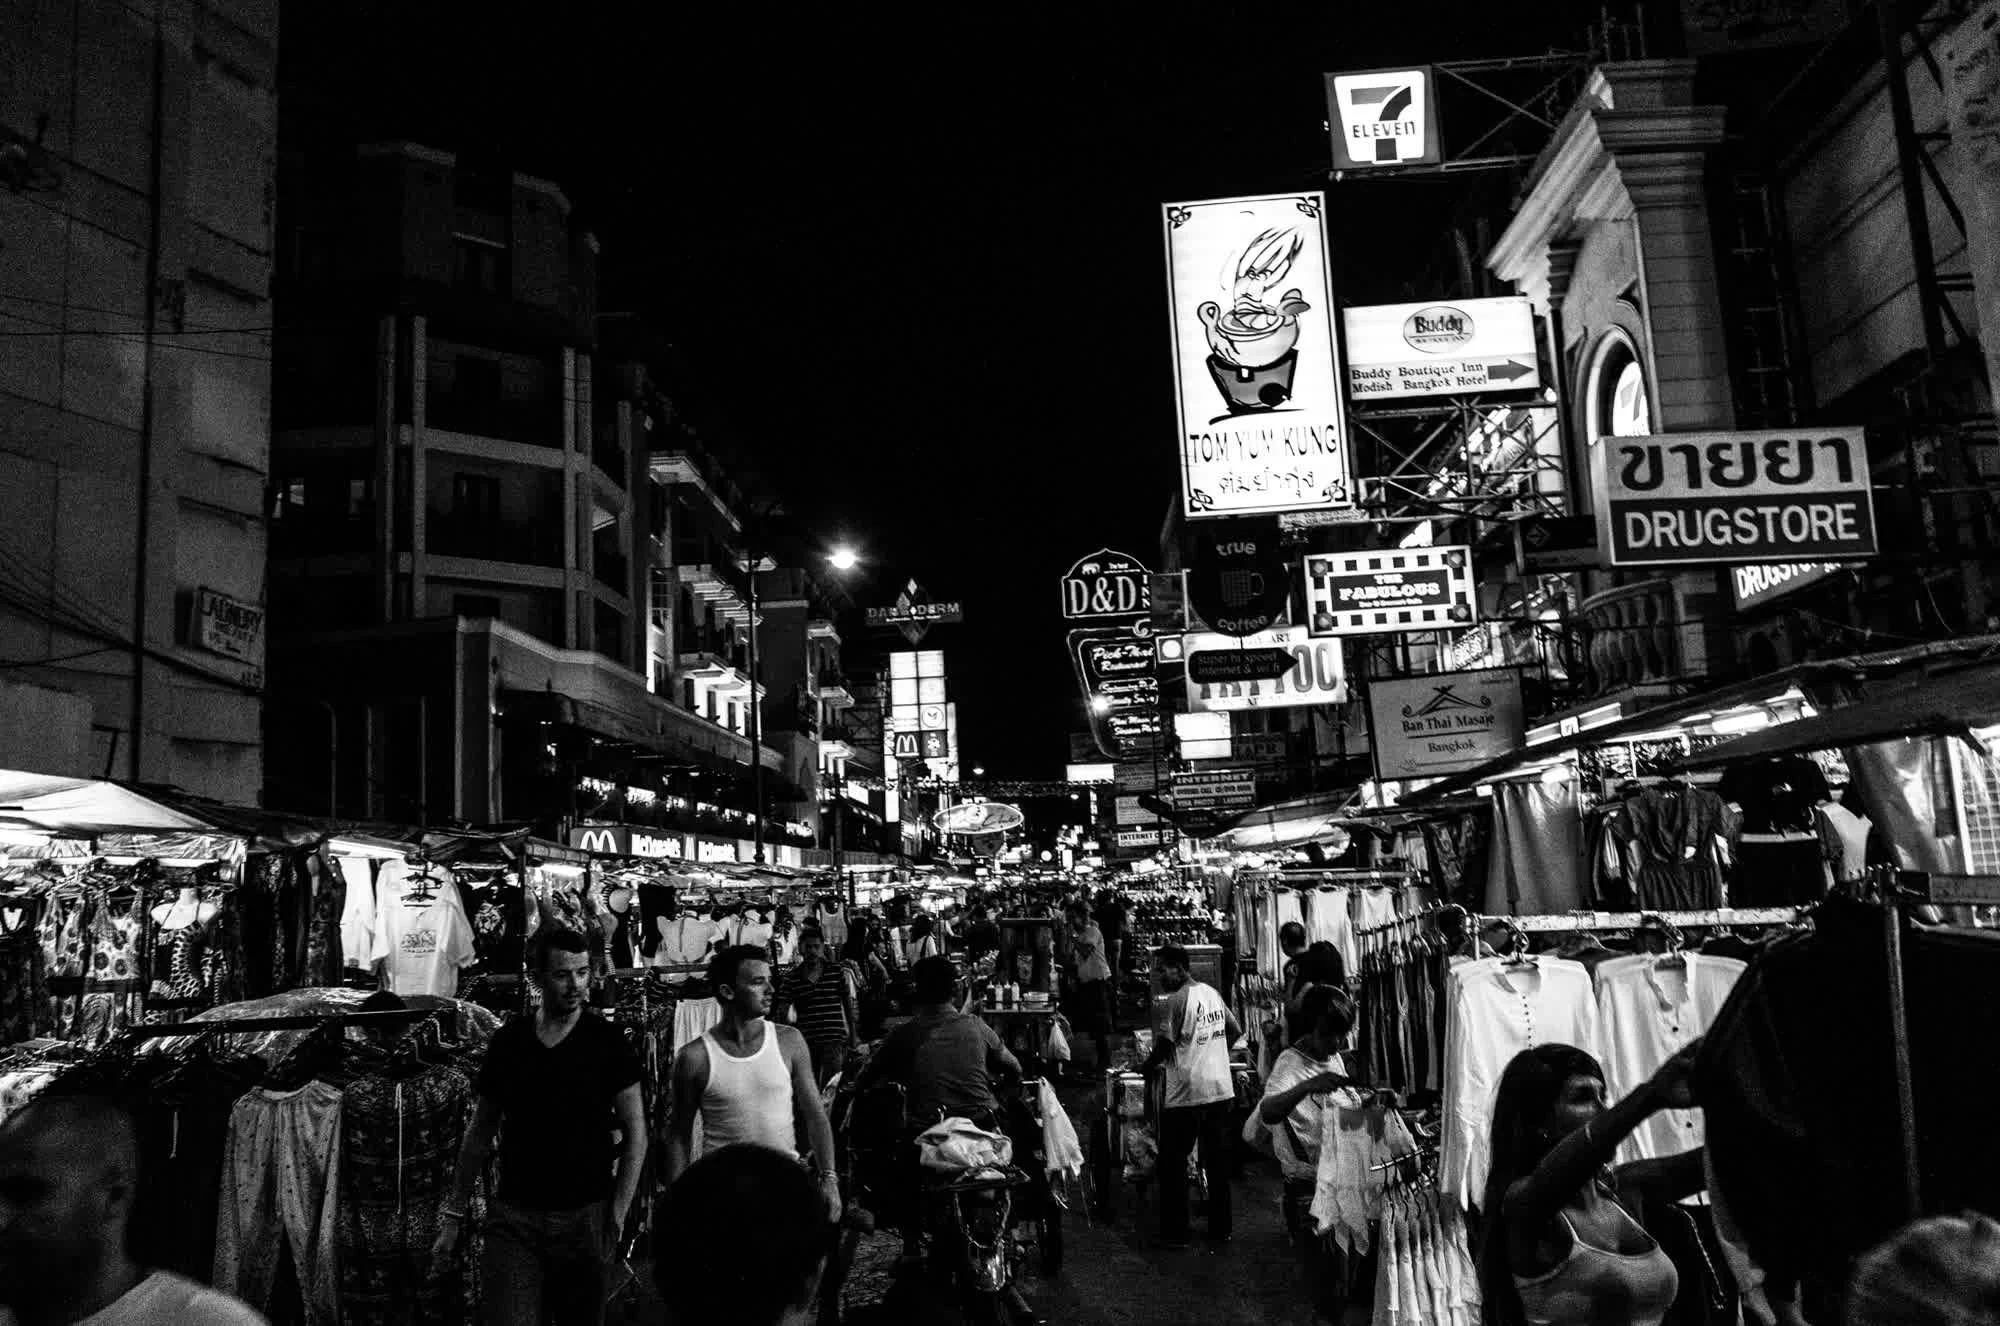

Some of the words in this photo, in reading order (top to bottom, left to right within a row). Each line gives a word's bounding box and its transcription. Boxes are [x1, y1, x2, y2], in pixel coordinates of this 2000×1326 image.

[1413, 315, 1464, 335] Buddy
[1352, 368, 1392, 381] Buddy
[1398, 364, 1456, 377] Boutique
[1462, 362, 1484, 373] Inn
[1352, 381, 1393, 394] Modish
[1403, 378, 1451, 392] Bangkok
[1456, 374, 1488, 387] Hotel
[1189, 432, 1230, 464] TOM
[1282, 424, 1338, 457] KUNG
[1618, 437, 1853, 491] ขายยา
[1625, 503, 1860, 549] DRUGSTORE
[1215, 539, 1257, 558] true
[1373, 574, 1403, 585] THE
[1068, 576, 1137, 614] D&D
[1141, 574, 1151, 609] INN
[1338, 582, 1441, 601] FABULOUS
[1216, 615, 1269, 632] coffee
[1402, 719, 1424, 733] Ban
[1426, 716, 1452, 729] Thai
[1428, 739, 1476, 755] Bangkok
[1175, 773, 1250, 785] INTERNET
[631, 833, 681, 858] McDonald's
[1121, 832, 1153, 841] INTERNET
